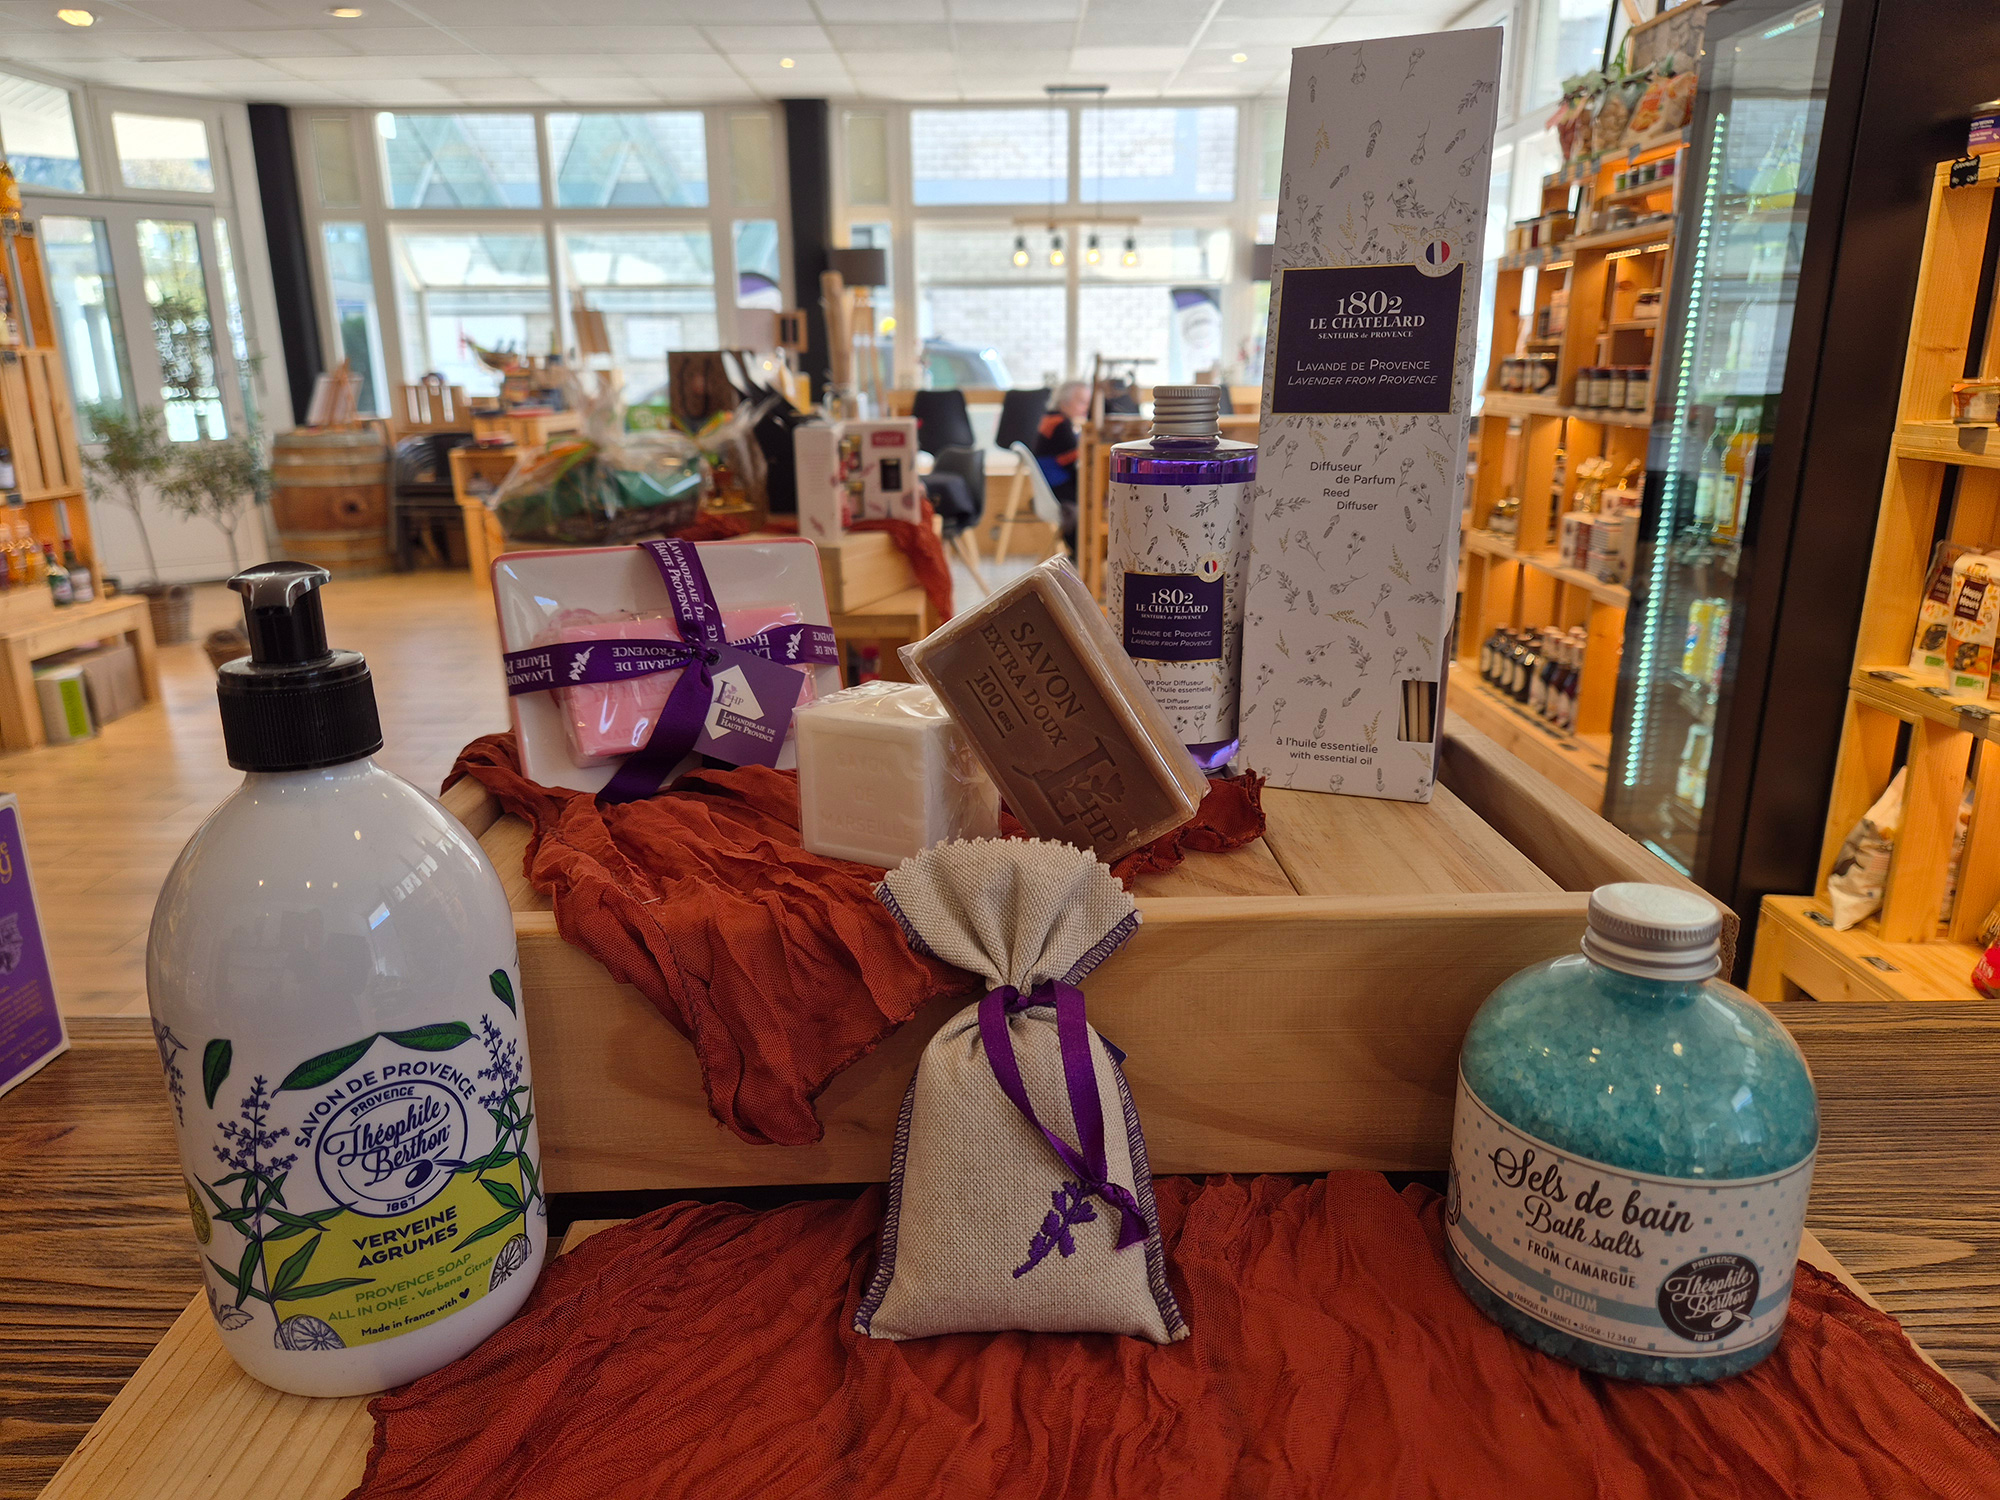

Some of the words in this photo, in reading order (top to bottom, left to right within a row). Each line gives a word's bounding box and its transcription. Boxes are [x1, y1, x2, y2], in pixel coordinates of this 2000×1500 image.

[1421, 230, 1449, 247] MADE
[1451, 235, 1459, 245] IN
[1335, 290, 1403, 316] 1802
[1309, 318, 1327, 330] LE
[1332, 315, 1425, 329] CHATELARD
[1318, 332, 1359, 340] SENTEURS
[1310, 461, 1362, 471] Diffuseur
[1335, 475, 1350, 484] de
[1354, 475, 1395, 484] Parfum
[1323, 488, 1350, 497] Reed
[1337, 501, 1378, 510] Diffuser
[1136, 604, 1146, 612] LE
[1148, 605, 1208, 614] CHATELARD
[1151, 588, 1194, 604] 1802
[980, 623, 1027, 690] EXTRA
[1022, 689, 1068, 748] DOUX
[1010, 622, 1086, 719] SAVON
[973, 672, 1004, 709] 100
[999, 710, 1015, 733] GRS
[1276, 737, 1283, 745] à
[1286, 737, 1317, 748] l'huile
[1320, 742, 1378, 753] essentielle
[1290, 751, 1311, 760] with
[1314, 753, 1357, 764] essential
[1360, 757, 1372, 765] oil
[294, 1088, 346, 1148] SAVON
[346, 1071, 378, 1094] DE
[383, 1061, 477, 1100] PROVENCE
[350, 1086, 415, 1117] PROVENCE
[323, 1095, 450, 1167] Théophile
[362, 1127, 450, 1187] Berthon
[386, 1195, 416, 1212] 1867
[1488, 1147, 1568, 1203] Sels
[1574, 1180, 1614, 1219] de
[1621, 1189, 1694, 1233] bain
[352, 1205, 457, 1250] VERVEINE
[1524, 1194, 1587, 1243] Bath
[1589, 1230, 1645, 1259] salts
[358, 1223, 458, 1268] AGRUMES
[355, 1271, 434, 1302] PROVENCE
[437, 1253, 471, 1276] SOAP
[1527, 1239, 1560, 1266] FROM
[1564, 1257, 1637, 1289] CAMARGUE
[1691, 1256, 1738, 1270] PROVENCE
[328, 1310, 355, 1321] ALL
[358, 1305, 373, 1316] IN
[376, 1296, 408, 1312] ONE
[417, 1275, 462, 1297] Verbena
[465, 1256, 493, 1277] Citrus
[1553, 1284, 1598, 1313] OPIUM
[1665, 1265, 1754, 1302] Théophile
[361, 1324, 390, 1337] Made
[393, 1320, 402, 1329] in
[404, 1308, 436, 1325] france
[437, 1297, 458, 1312] with
[1514, 1292, 1539, 1310] FABRIQUE
[1540, 1307, 1548, 1316] EN
[1550, 1310, 1571, 1326] FRANCE
[1685, 1289, 1749, 1319] Berthon
